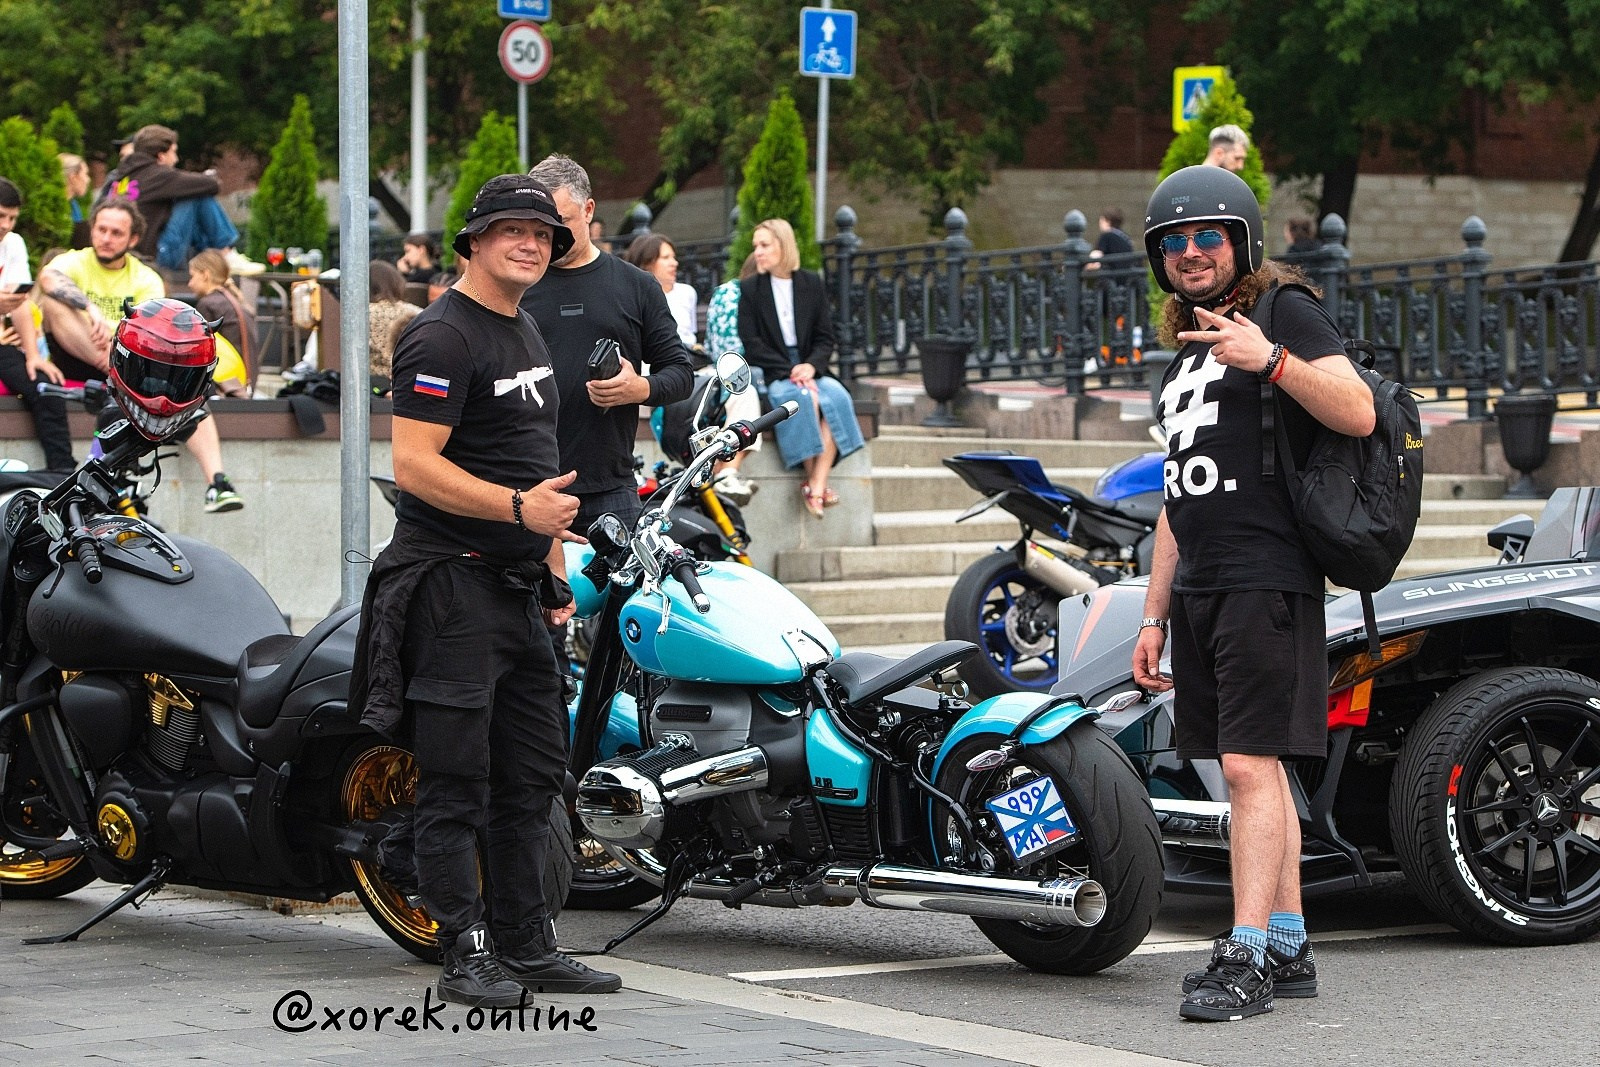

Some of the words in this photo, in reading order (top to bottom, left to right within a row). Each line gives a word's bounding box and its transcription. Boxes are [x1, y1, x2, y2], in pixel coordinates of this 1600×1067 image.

[512, 41, 539, 62] 50
[1402, 565, 1597, 600] SLINGSHOT
[1007, 786, 1041, 812] 999
[1447, 798, 1530, 926] SLINGSHOT
